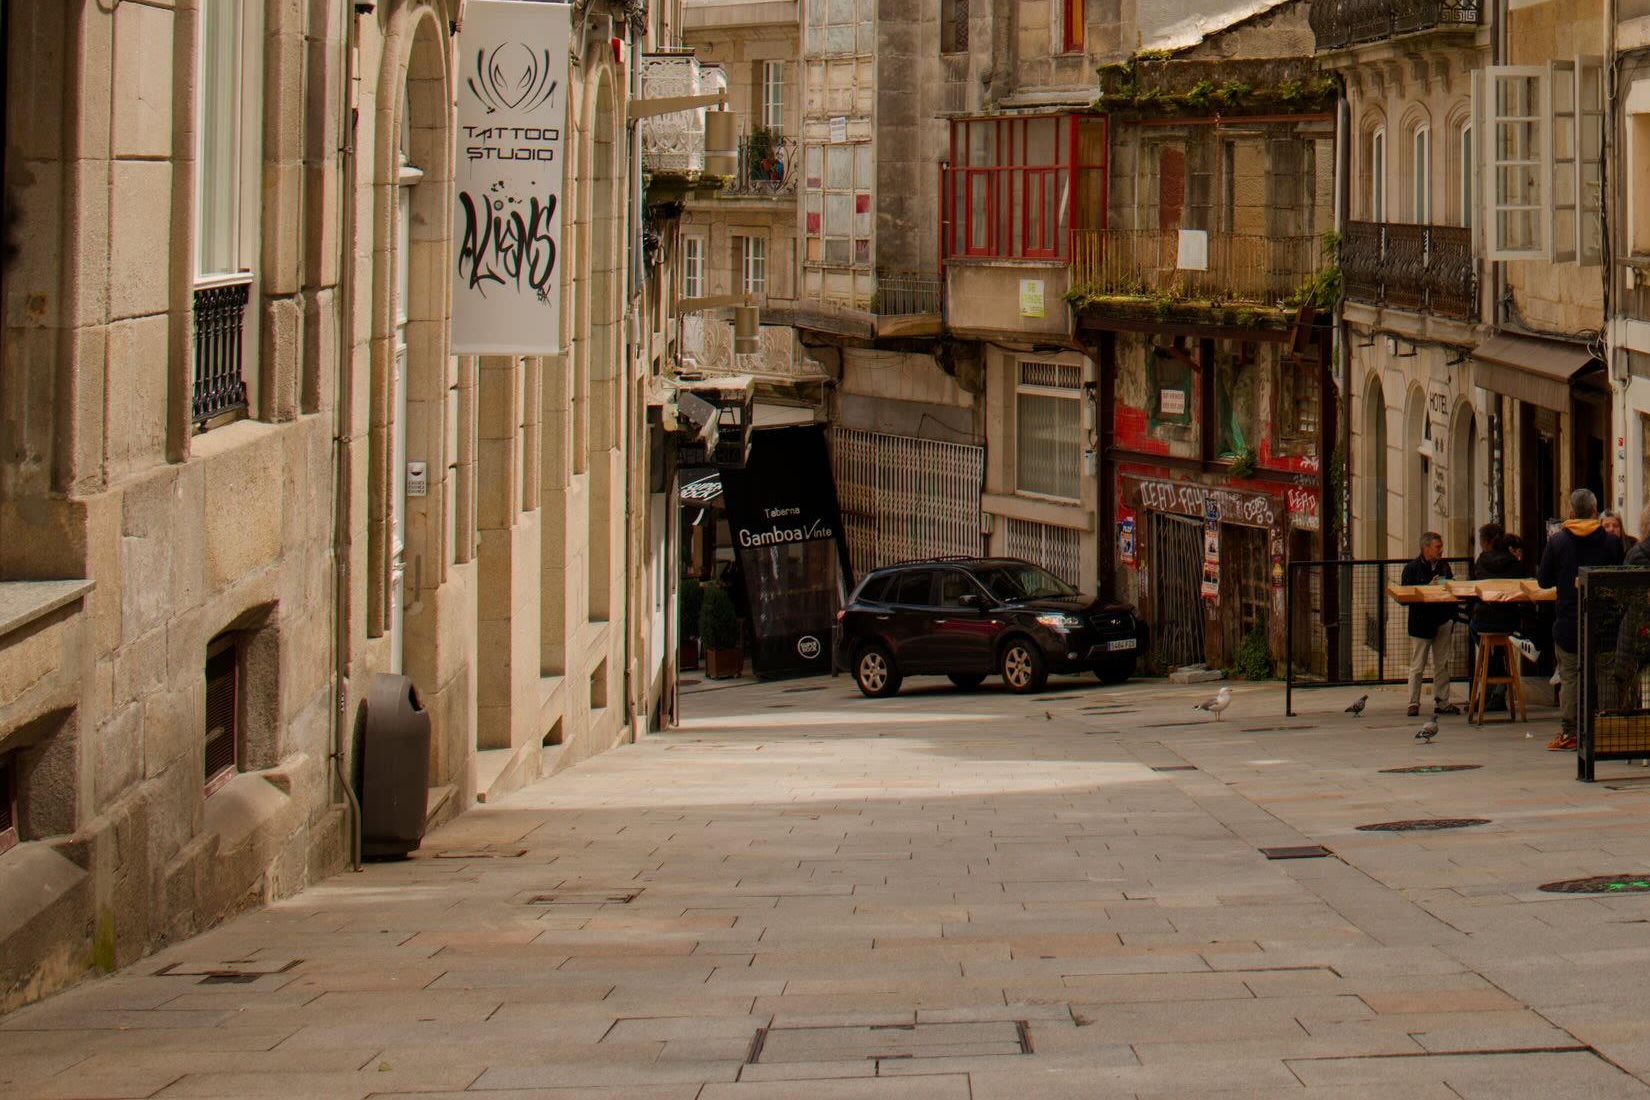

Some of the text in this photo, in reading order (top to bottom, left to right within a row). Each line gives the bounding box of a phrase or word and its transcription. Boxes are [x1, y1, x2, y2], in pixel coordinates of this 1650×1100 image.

[462, 126, 559, 141] TATTOO
[466, 147, 554, 161] STUDIO
[1430, 391, 1448, 416] HOTEL
[764, 507, 800, 519] Taberna
[740, 518, 832, 547] Gamboa Vinte
